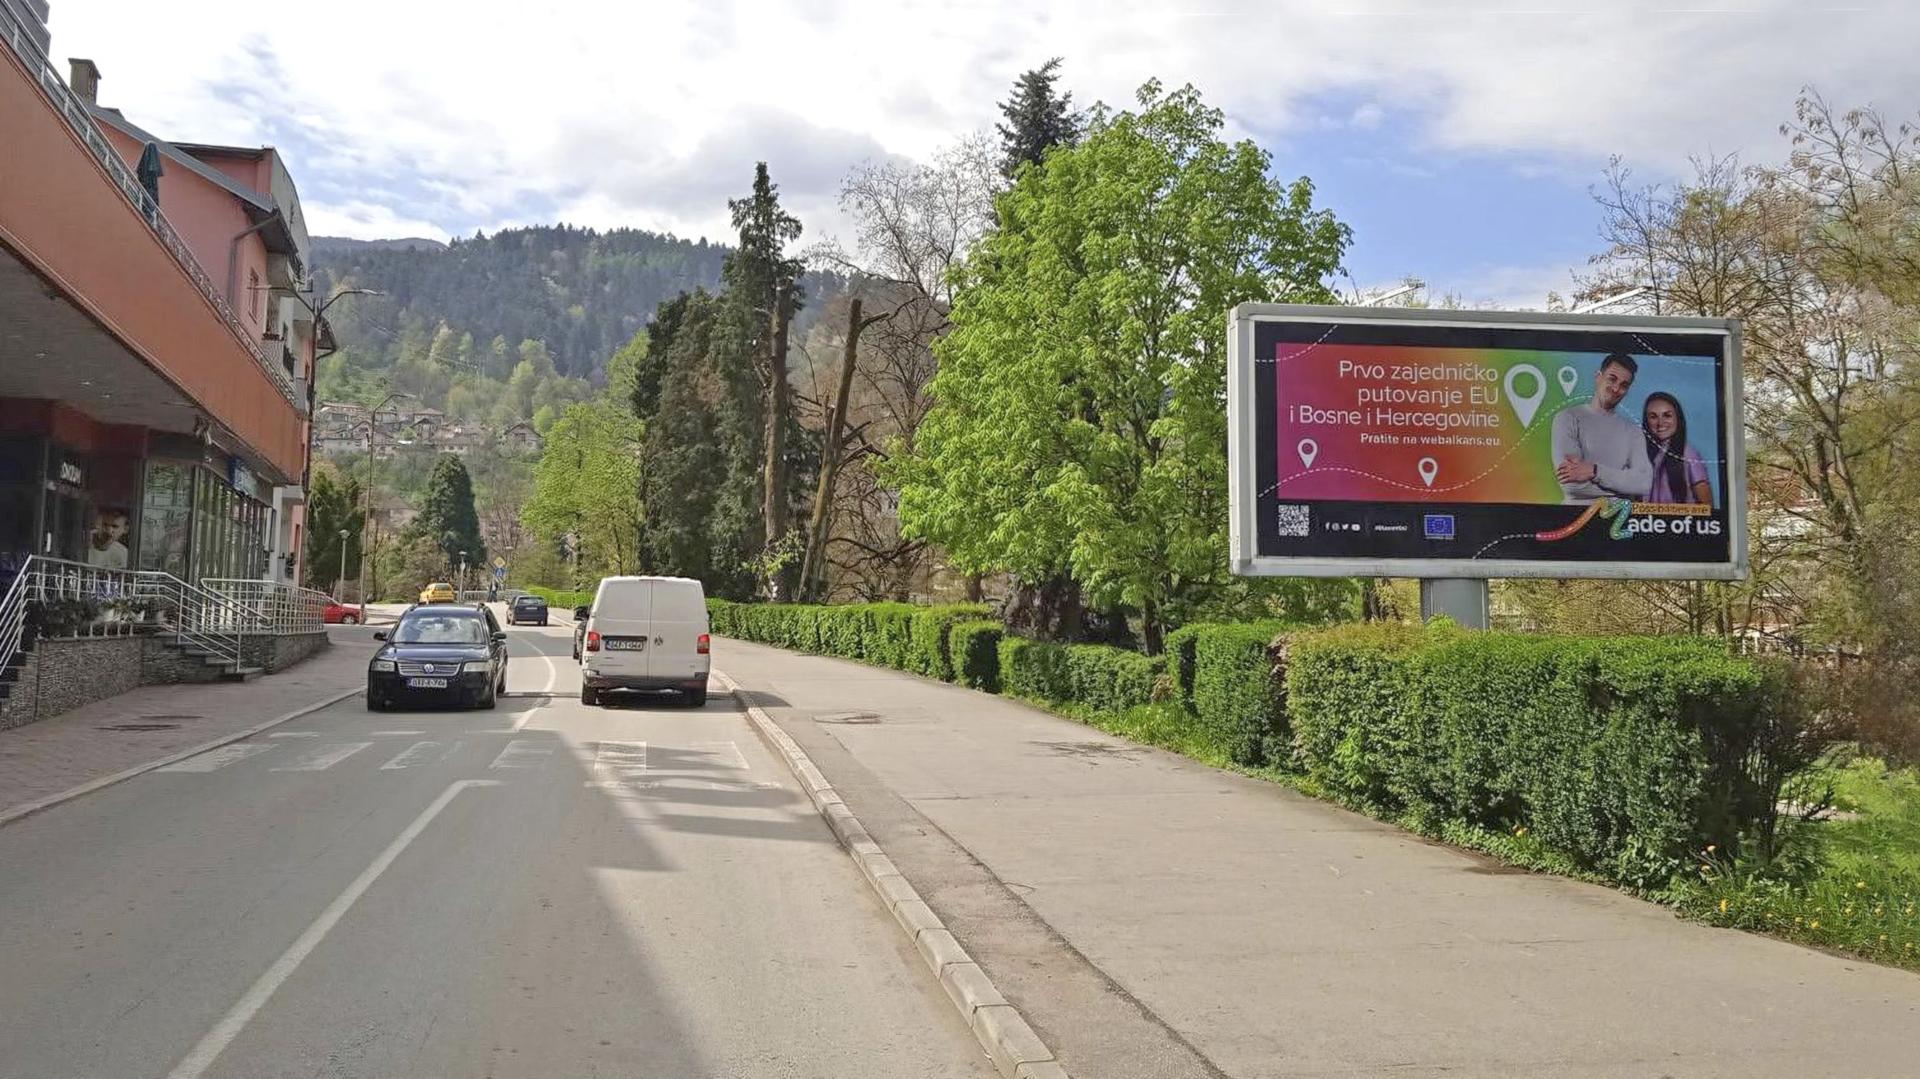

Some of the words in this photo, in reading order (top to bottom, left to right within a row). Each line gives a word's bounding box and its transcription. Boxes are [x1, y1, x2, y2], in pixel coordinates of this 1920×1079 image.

[1339, 360, 1385, 380] Prvo
[1391, 362, 1498, 385] zajedničko
[1358, 386, 1463, 408] putovanje
[1470, 386, 1499, 405] EU
[1289, 405, 1294, 423] i
[1300, 405, 1361, 425] Bosne
[1367, 407, 1371, 426] i
[1376, 408, 1500, 431] Hercegovine
[1360, 433, 1400, 445] Pratite
[1403, 435, 1417, 445] na
[1419, 433, 1500, 446] webalkans.eu
[1670, 516, 1694, 534] of
[1696, 519, 1721, 535] us
